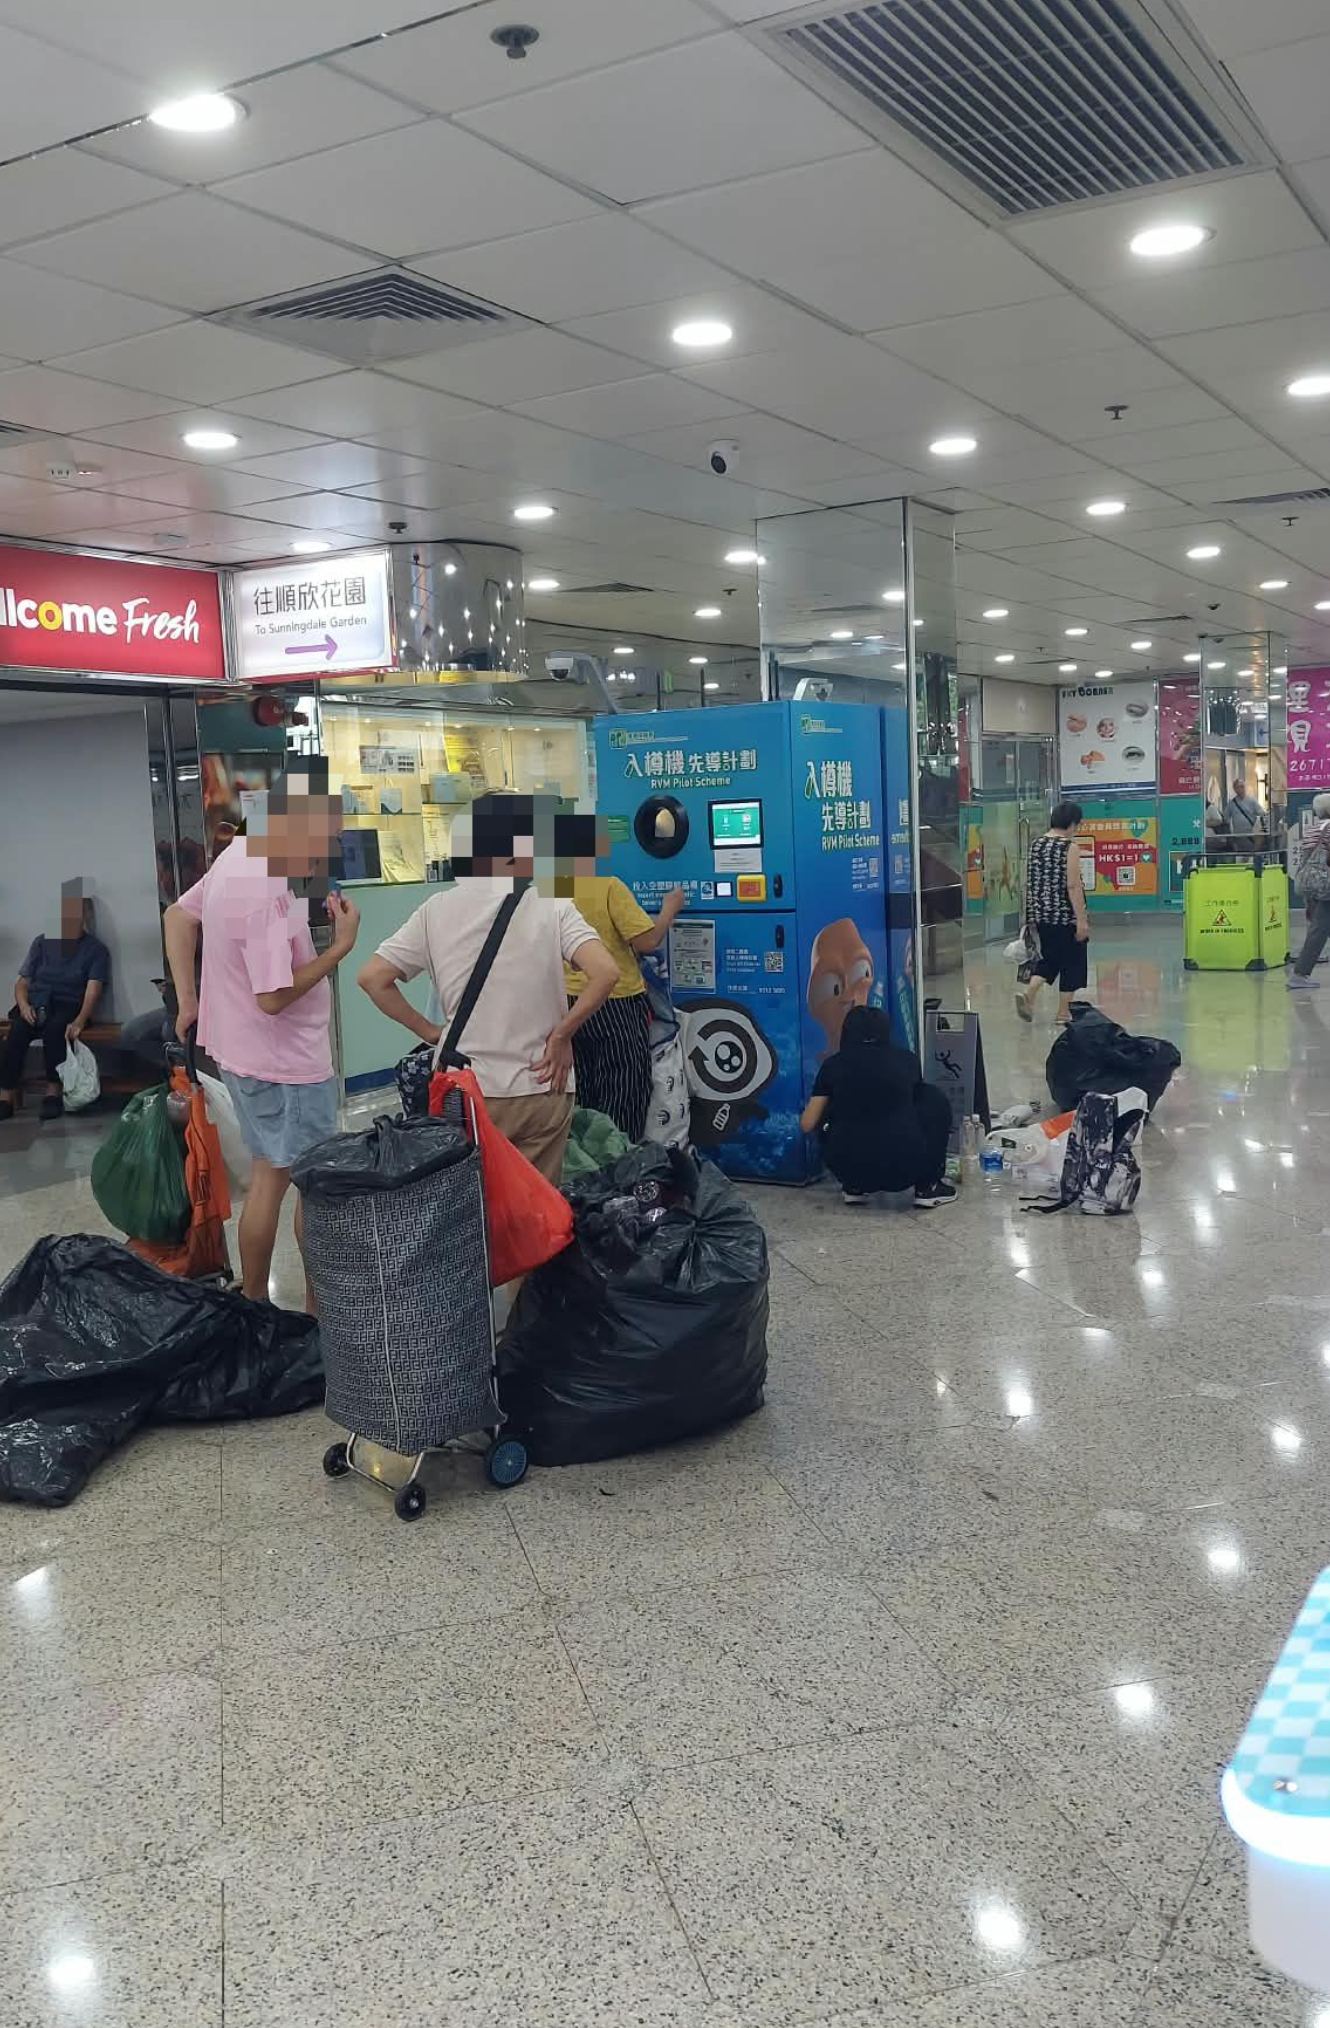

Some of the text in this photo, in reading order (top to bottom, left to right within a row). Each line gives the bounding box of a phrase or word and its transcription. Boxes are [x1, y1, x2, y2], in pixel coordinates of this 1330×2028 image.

[253, 577, 366, 616] 往順欣花園
[121, 597, 199, 644] Fresh
[255, 615, 367, 635] To Sunningdale Garden
[624, 748, 757, 778] 入樽機 先導計劃
[1290, 757, 1330, 771] 2671
[651, 776, 731, 789] RVM Pilot Scheme
[804, 760, 852, 799] 入樽機
[822, 800, 871, 832] 先導計劃
[822, 836, 838, 851] RVM
[839, 834, 853, 849] Pilot
[855, 833, 880, 847] Scheme
